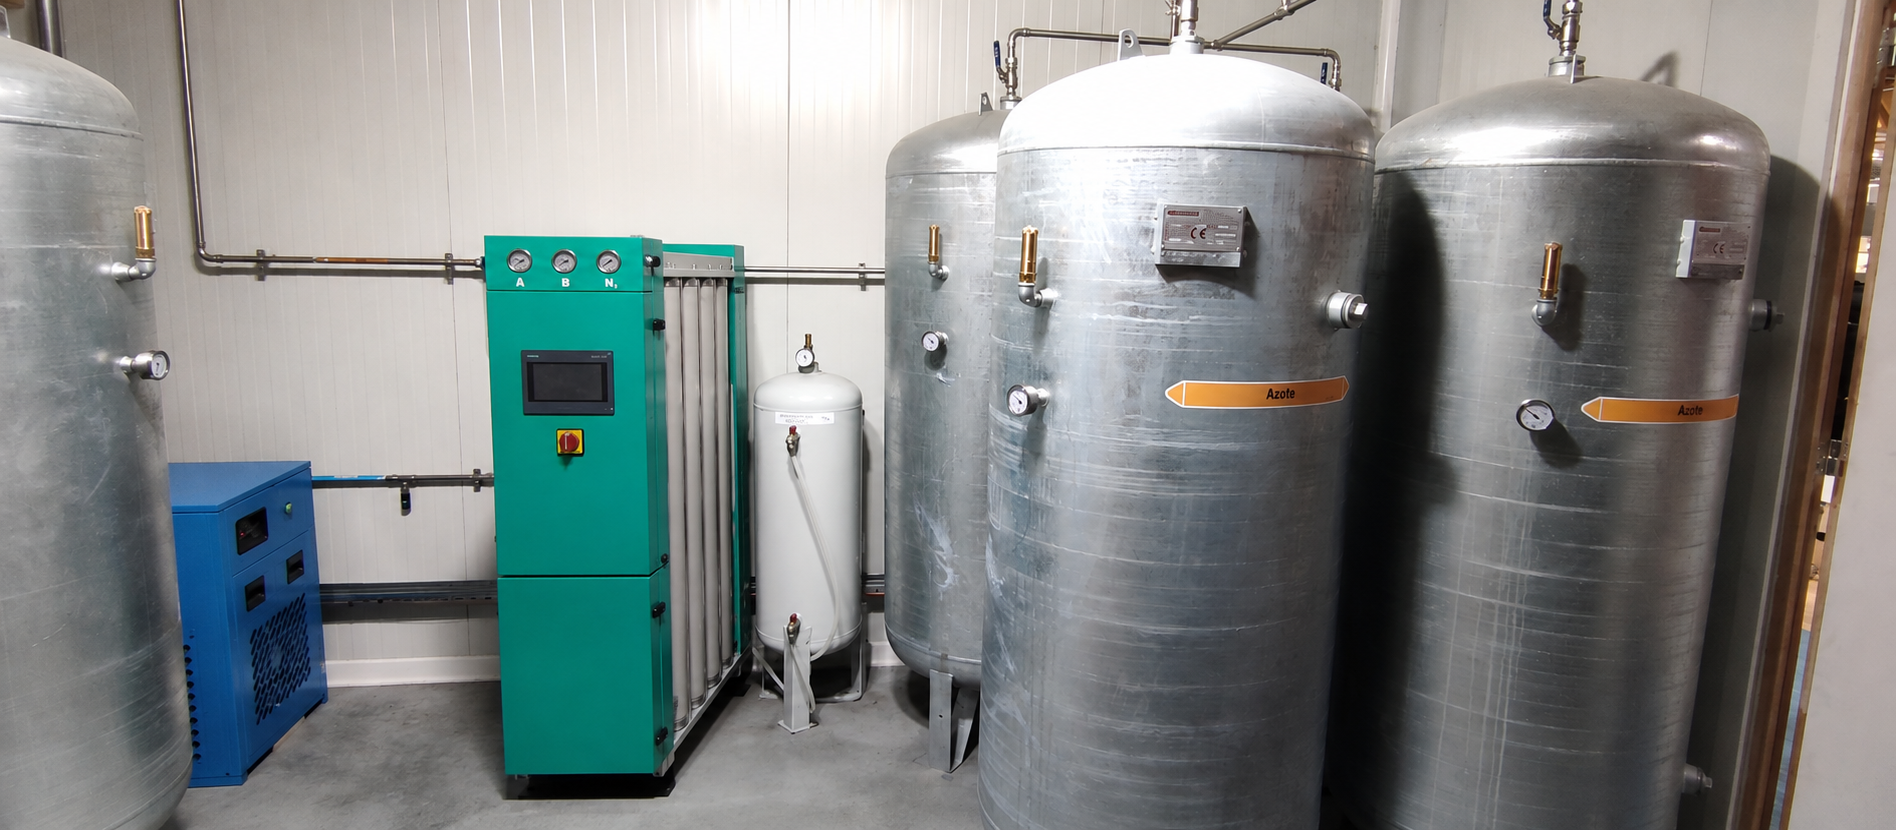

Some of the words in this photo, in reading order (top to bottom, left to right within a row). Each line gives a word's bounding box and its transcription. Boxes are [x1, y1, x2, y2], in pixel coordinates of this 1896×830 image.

[515, 277, 525, 288] A
[561, 278, 570, 288] B
[1266, 387, 1295, 400] Azote
[1677, 404, 1704, 416] Azote
